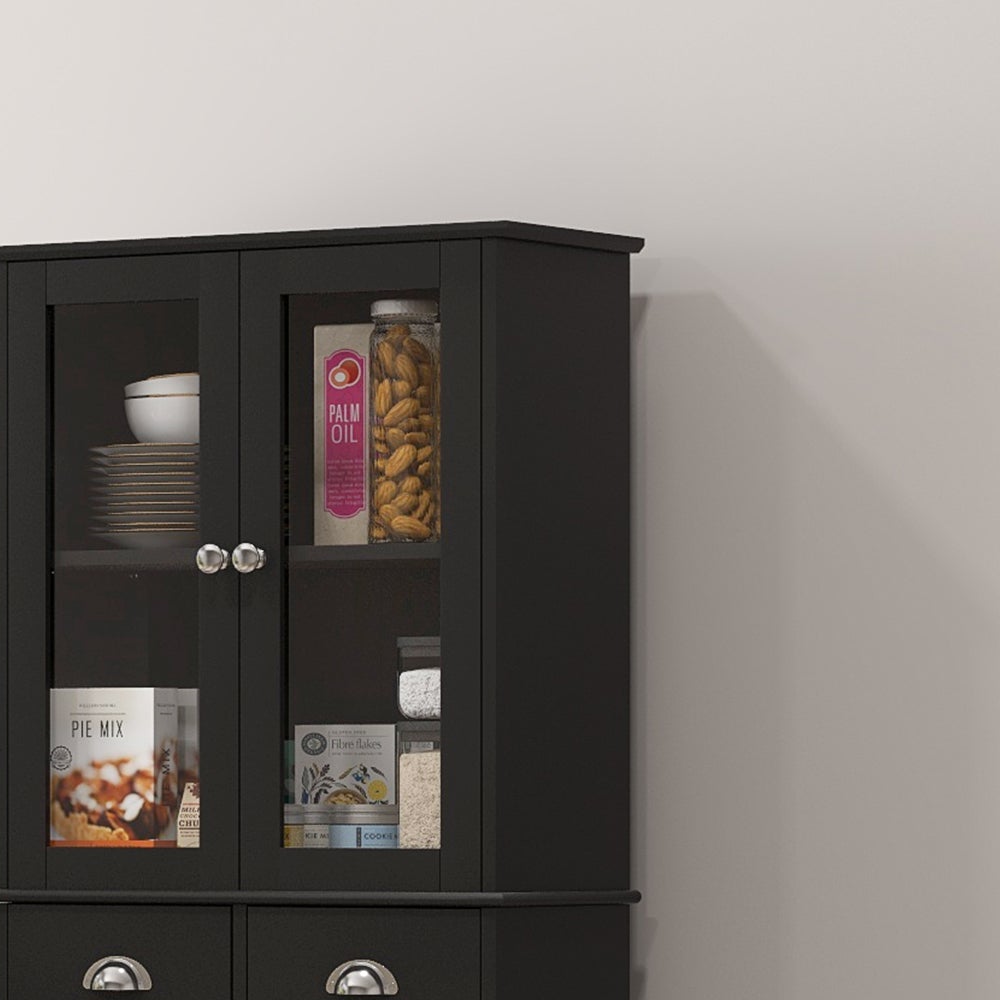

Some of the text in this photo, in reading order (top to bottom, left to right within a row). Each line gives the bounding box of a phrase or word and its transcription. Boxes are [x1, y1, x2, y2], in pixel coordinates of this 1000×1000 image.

[328, 403, 360, 423] PALM
[331, 424, 358, 444] OIL
[71, 719, 124, 738] PIE MIX
[331, 737, 354, 750] Fibre
[355, 737, 383, 750] flakes
[161, 747, 171, 775] MIX
[363, 832, 393, 840] COOKIE
